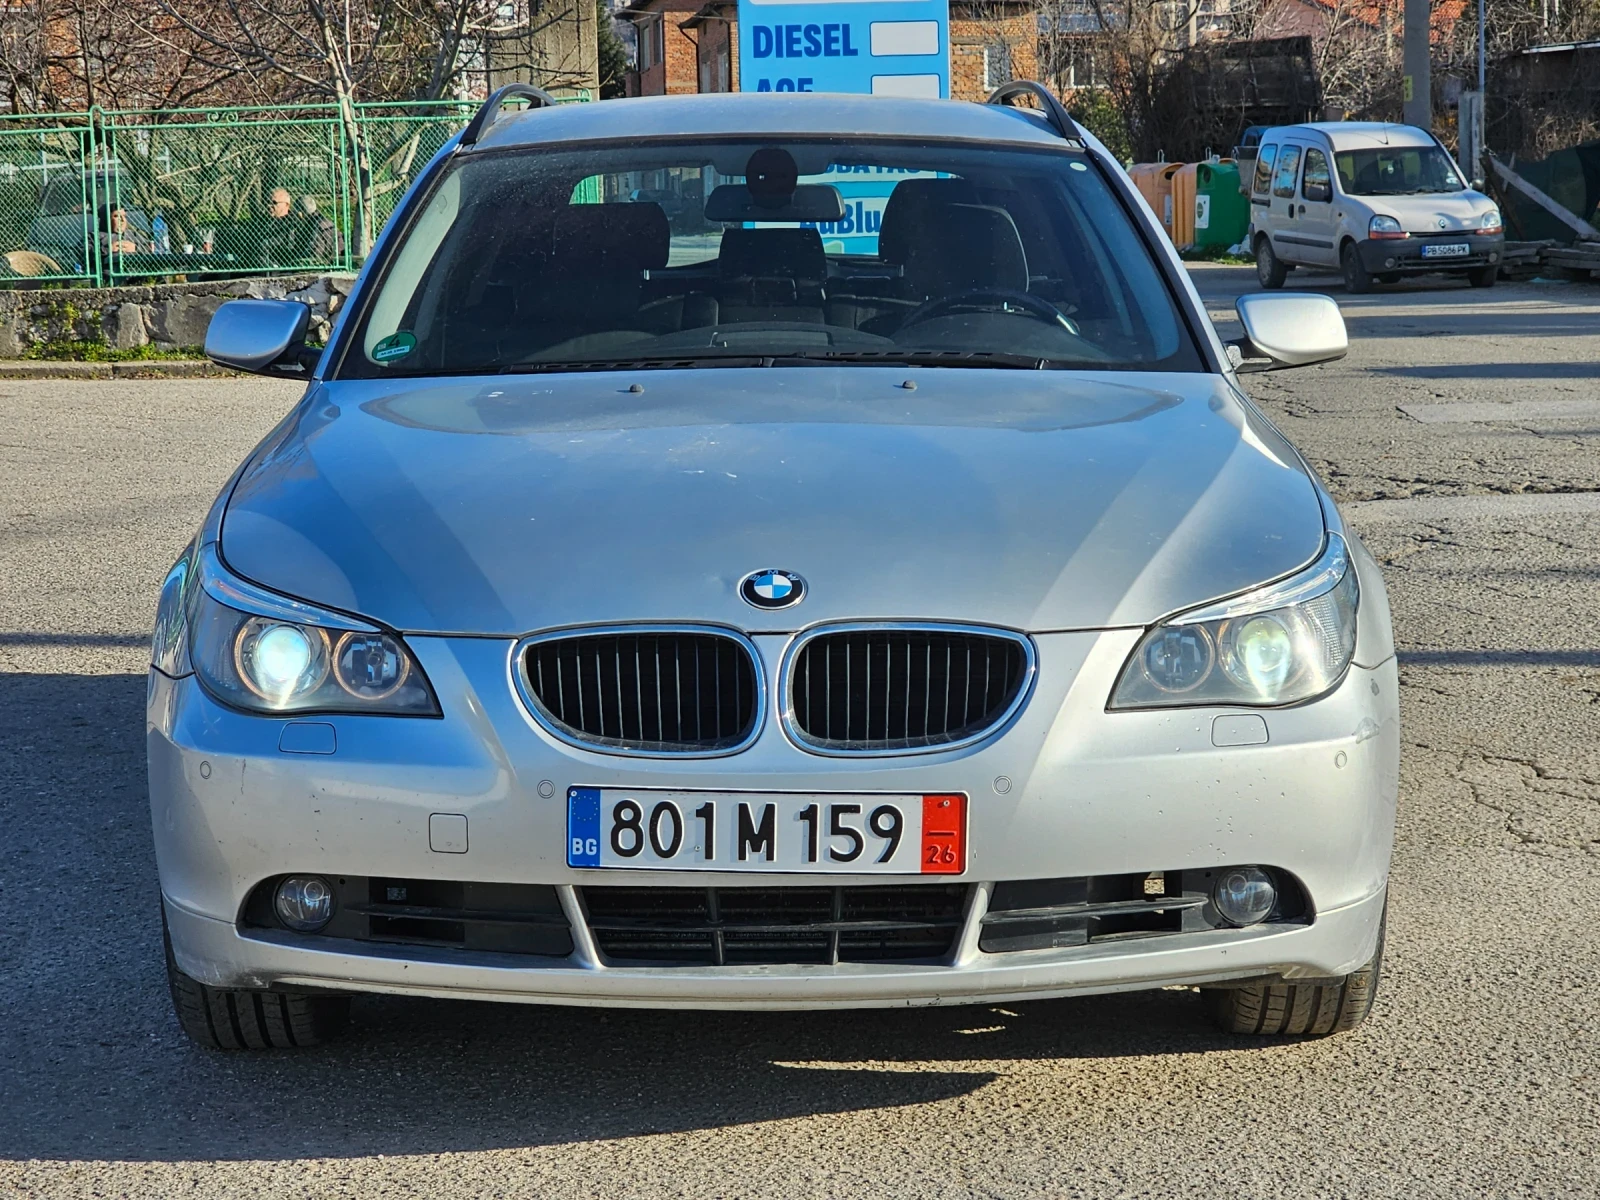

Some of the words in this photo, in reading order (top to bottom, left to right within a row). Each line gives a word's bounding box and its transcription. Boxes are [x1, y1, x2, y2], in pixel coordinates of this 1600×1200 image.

[752, 24, 859, 58] DIESEL
[749, 570, 800, 581] BMW
[610, 799, 714, 860] 801
[738, 801, 777, 861] M
[799, 803, 904, 864] 159
[571, 838, 598, 855] BG
[925, 844, 957, 865] 26
